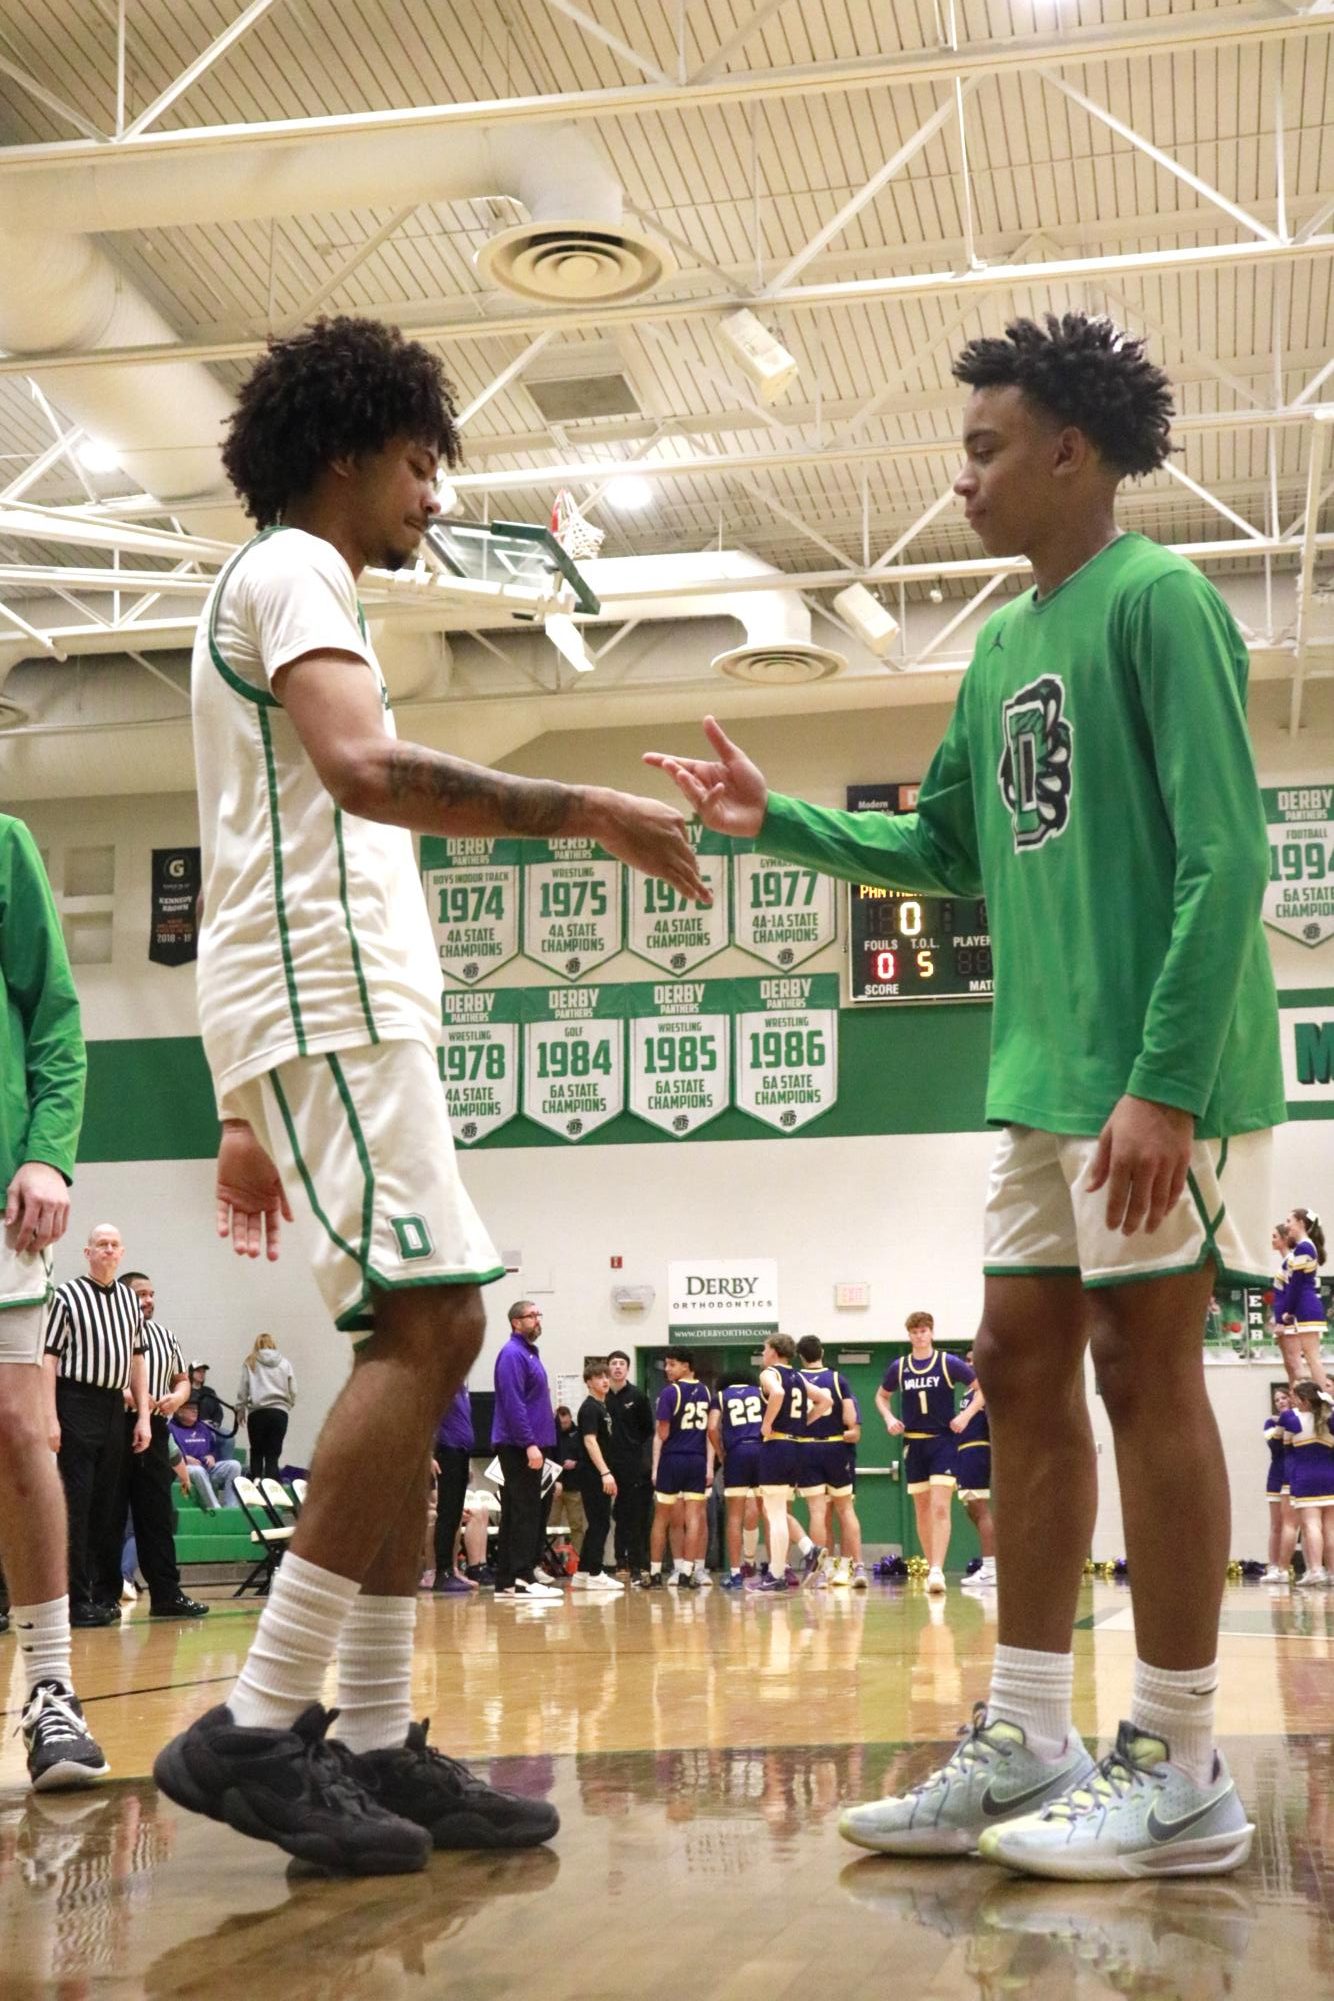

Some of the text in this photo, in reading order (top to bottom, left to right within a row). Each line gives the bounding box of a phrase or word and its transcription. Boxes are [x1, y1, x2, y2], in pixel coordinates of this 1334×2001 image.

[858, 800, 888, 809] Modern
[1278, 789, 1333, 811] DERBY
[1285, 810, 1328, 821] PANTHERS
[1286, 828, 1328, 840] FOOTBALL
[447, 838, 495, 856] DERBY
[548, 837, 596, 850] DERBY
[452, 855, 489, 865] PANTHERS
[554, 849, 592, 860] PANTHERS
[169, 859, 185, 877] G
[552, 867, 594, 878] WRESTLING
[433, 874, 453, 884] BOYS
[485, 872, 508, 881] TRACK
[750, 870, 818, 908] 1977
[1283, 888, 1300, 902] 6A
[438, 885, 504, 923] 1974
[540, 881, 607, 918] 1975
[654, 917, 703, 932] 4A STATE
[752, 912, 818, 928] 4A-1A STATE
[899, 901, 922, 936] 0
[447, 928, 495, 942] 4A STATE
[549, 923, 597, 937] 4A STATE
[753, 928, 818, 944] CHAMPIONS
[541, 938, 604, 953] CHAMPIONS
[646, 932, 711, 949] CHAMPIONS
[864, 939, 899, 951] FOULS
[910, 937, 940, 949] T.O.L.
[440, 942, 502, 958] CHAMPIONS
[877, 951, 934, 979] 0 5
[654, 983, 706, 1004] DERBY
[760, 978, 812, 999] DERBY
[864, 984, 899, 995] SCORE
[445, 993, 495, 1013] DERBY
[549, 988, 599, 1009] DERBY
[766, 998, 806, 1009] PANTHERS
[555, 1008, 593, 1019] PANTHERS
[660, 1003, 699, 1015] PANTHERS
[451, 1012, 489, 1023] PANTHERS
[765, 1016, 809, 1028] WRESTLING
[565, 1027, 583, 1037] GOLF
[658, 1021, 702, 1033] WRESTLING
[448, 1030, 492, 1041] WRESTLING
[644, 1035, 717, 1074] 1985
[750, 1029, 825, 1069] 1986
[436, 1043, 505, 1081] 1978
[537, 1039, 612, 1078] 1984
[656, 1078, 705, 1094] 6A STATE
[762, 1074, 813, 1089] 6A STATE
[445, 1086, 494, 1102] 4A STATE
[550, 1083, 598, 1098] 6A STATE
[755, 1089, 821, 1105] CHAMPIONS
[542, 1098, 606, 1114] CHAMPIONS
[648, 1093, 713, 1110] CHAMPIONS
[389, 1214, 434, 1260] D
[685, 1276, 759, 1299] DERBY
[673, 1300, 773, 1310] ORTHODONTICS
[1248, 1287, 1264, 1358] ERBY
[904, 1376, 940, 1390] VALLEY
[681, 1402, 709, 1430] 25
[728, 1396, 763, 1427] 22
[918, 1390, 928, 1415] 1
